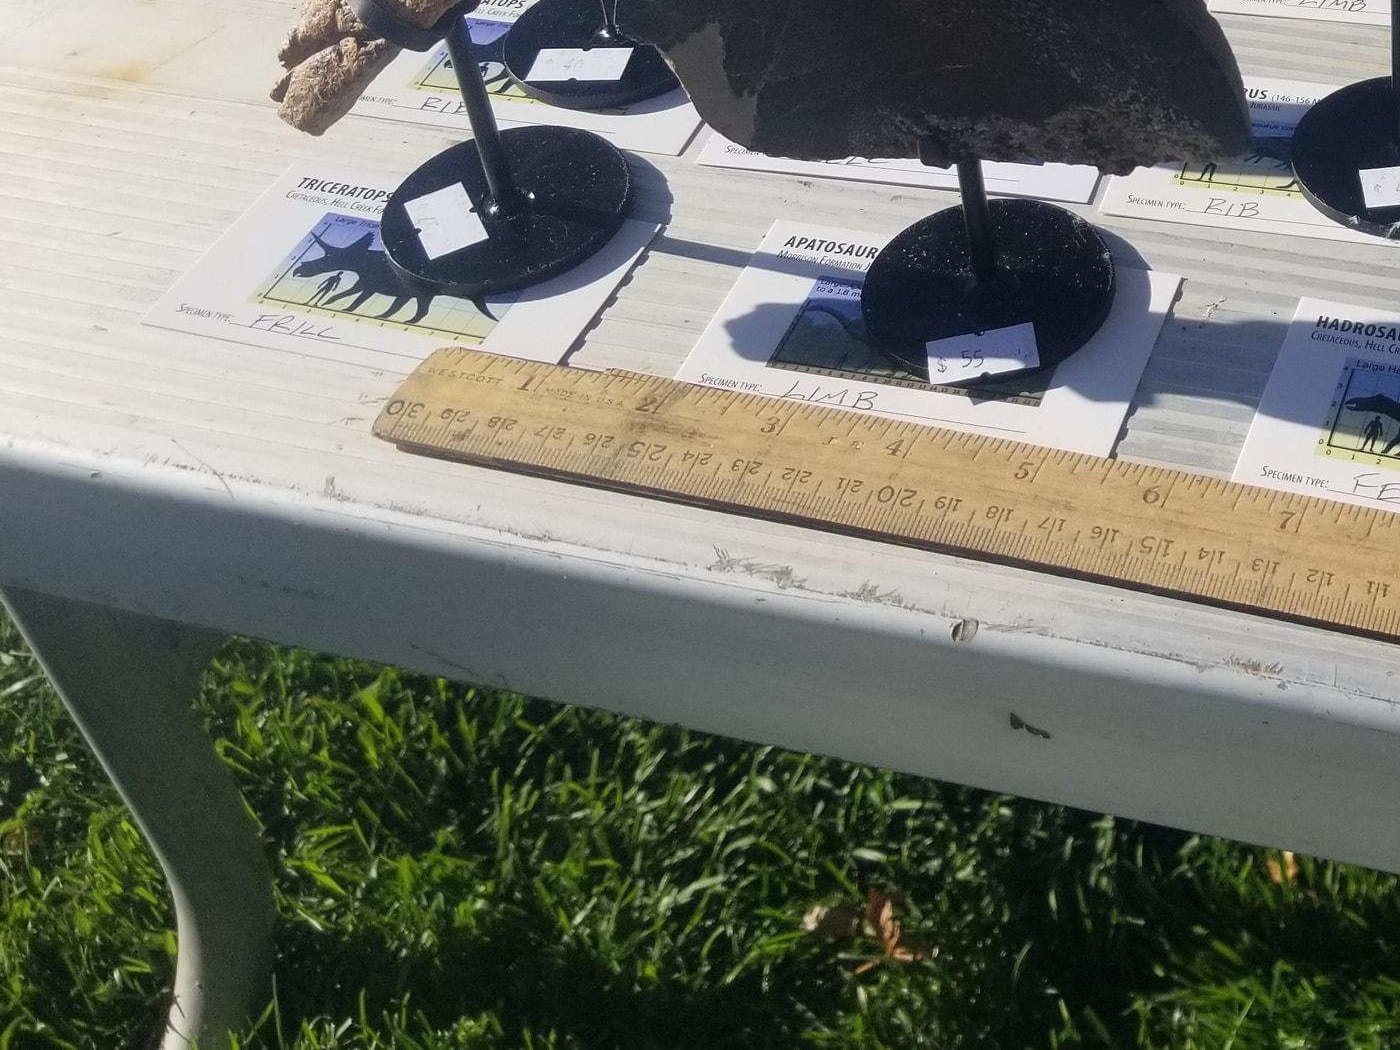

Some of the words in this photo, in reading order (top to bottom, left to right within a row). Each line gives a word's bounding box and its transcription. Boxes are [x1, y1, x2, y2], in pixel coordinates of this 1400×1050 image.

[297, 177, 395, 203] TRICERATOPS
[1204, 197, 1260, 218] RIB
[784, 235, 879, 260] APATOSAUR
[820, 255, 863, 270] FORMATION
[1311, 330, 1361, 349] CRETACEOUS,
[1365, 340, 1385, 352] HELL
[937, 357, 948, 374] $
[961, 350, 984, 368] 55
[1356, 359, 1385, 372] Large
[427, 366, 504, 386] WESTCOTT
[698, 373, 739, 390] SPECIMEN
[739, 382, 763, 393] TYPE:
[779, 380, 880, 411] LIMB
[387, 400, 426, 419] 30
[440, 407, 471, 423] 29
[487, 416, 519, 432] 28
[534, 425, 567, 440] 27
[583, 432, 615, 449] 26
[517, 375, 536, 392] 1
[635, 397, 658, 413] 2
[760, 416, 781, 434] 3
[884, 439, 905, 456] 4
[1014, 461, 1035, 480] 5
[1142, 485, 1162, 504] 6
[1279, 510, 1297, 530] 7
[627, 441, 668, 462] 25
[682, 449, 714, 466] 24
[731, 458, 764, 476] 23
[781, 467, 814, 484] 22
[837, 477, 865, 494] 21
[1260, 465, 1304, 484] SPECIMEN
[1305, 476, 1330, 489] TYPE:
[878, 485, 919, 508] 20
[934, 495, 963, 512] 19
[986, 505, 1015, 522] 18
[1038, 516, 1067, 533] 17
[1089, 525, 1120, 543] 16
[1140, 535, 1175, 558] 15
[1198, 547, 1226, 564] 14
[1251, 558, 1281, 576] 13
[1306, 568, 1336, 587] 12
[1367, 580, 1391, 598] 11
